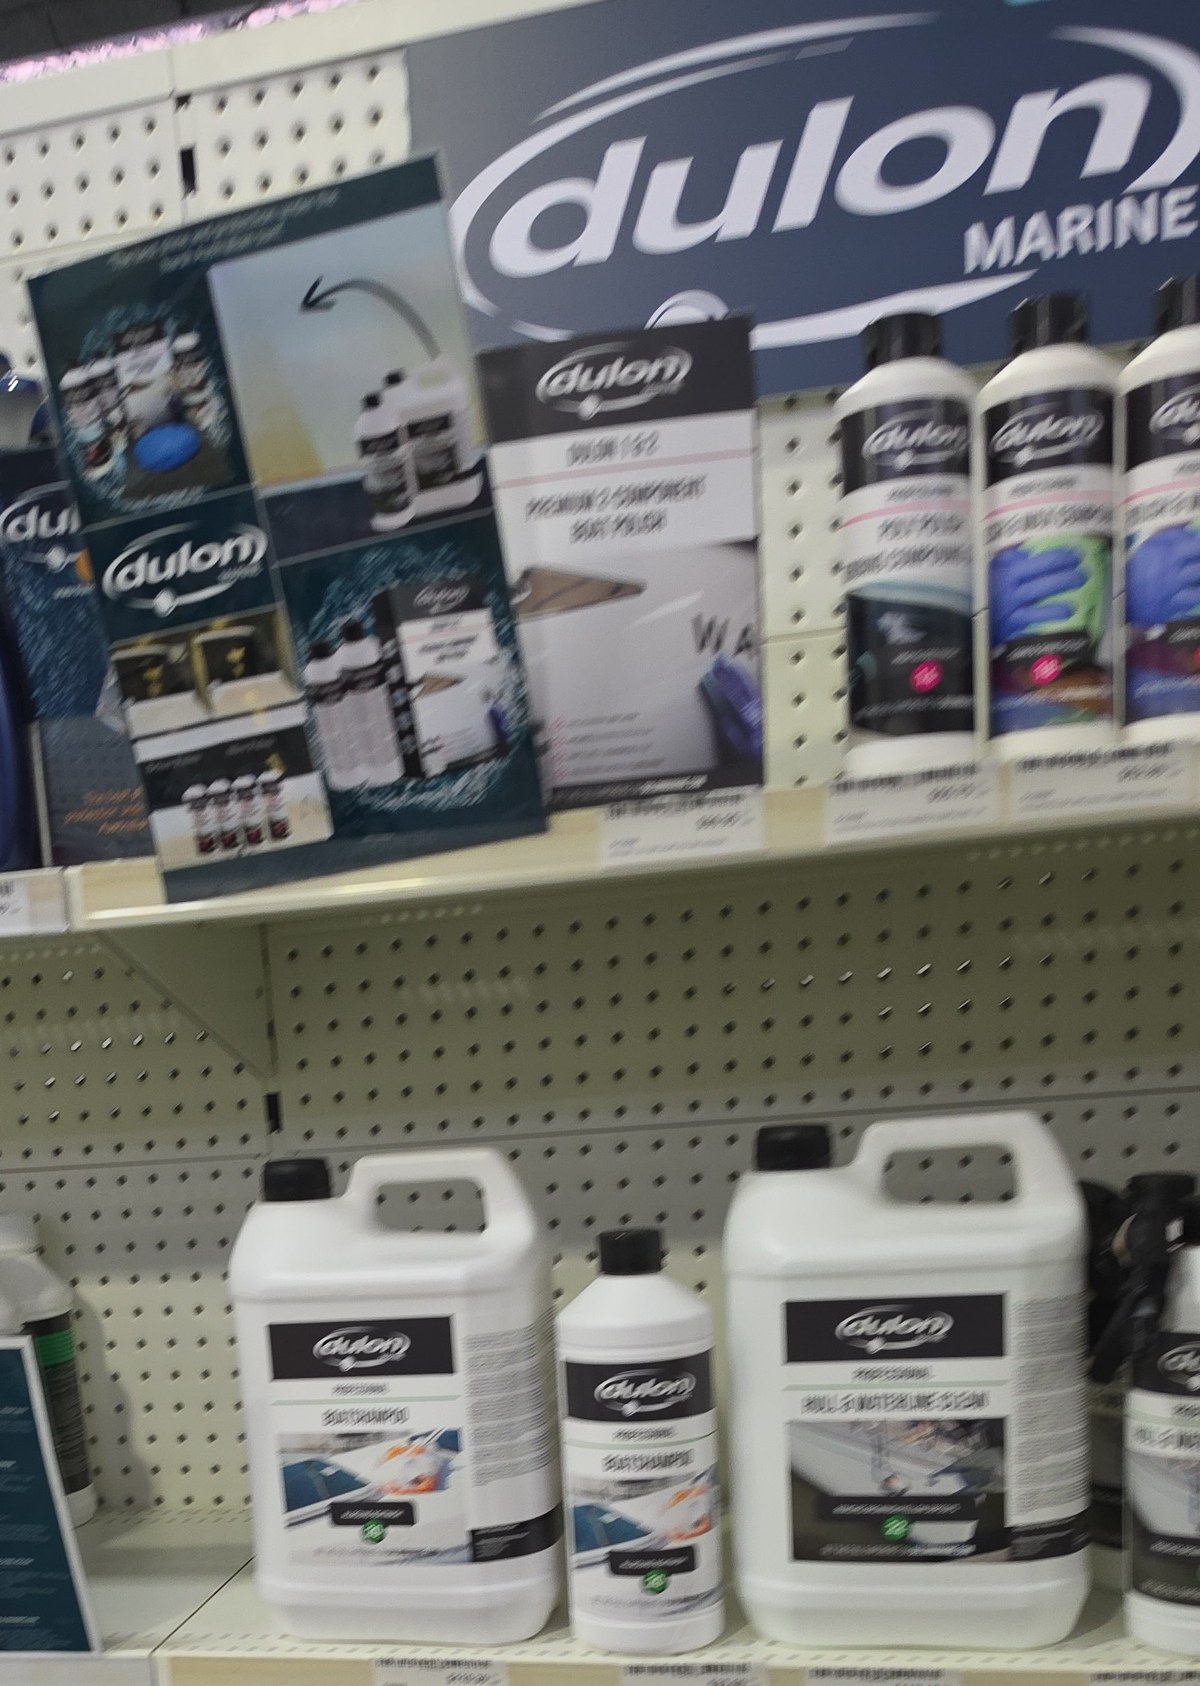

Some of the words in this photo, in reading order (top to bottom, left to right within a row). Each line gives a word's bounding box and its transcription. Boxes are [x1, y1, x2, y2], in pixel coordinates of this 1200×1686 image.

[488, 73, 1154, 278] dulon
[964, 184, 1199, 275] MARINE
[546, 357, 683, 396] dulon
[115, 540, 259, 593] dulon
[843, 1315, 945, 1336] dulon
[320, 1335, 404, 1356] dulon
[600, 1378, 689, 1399] dulon
